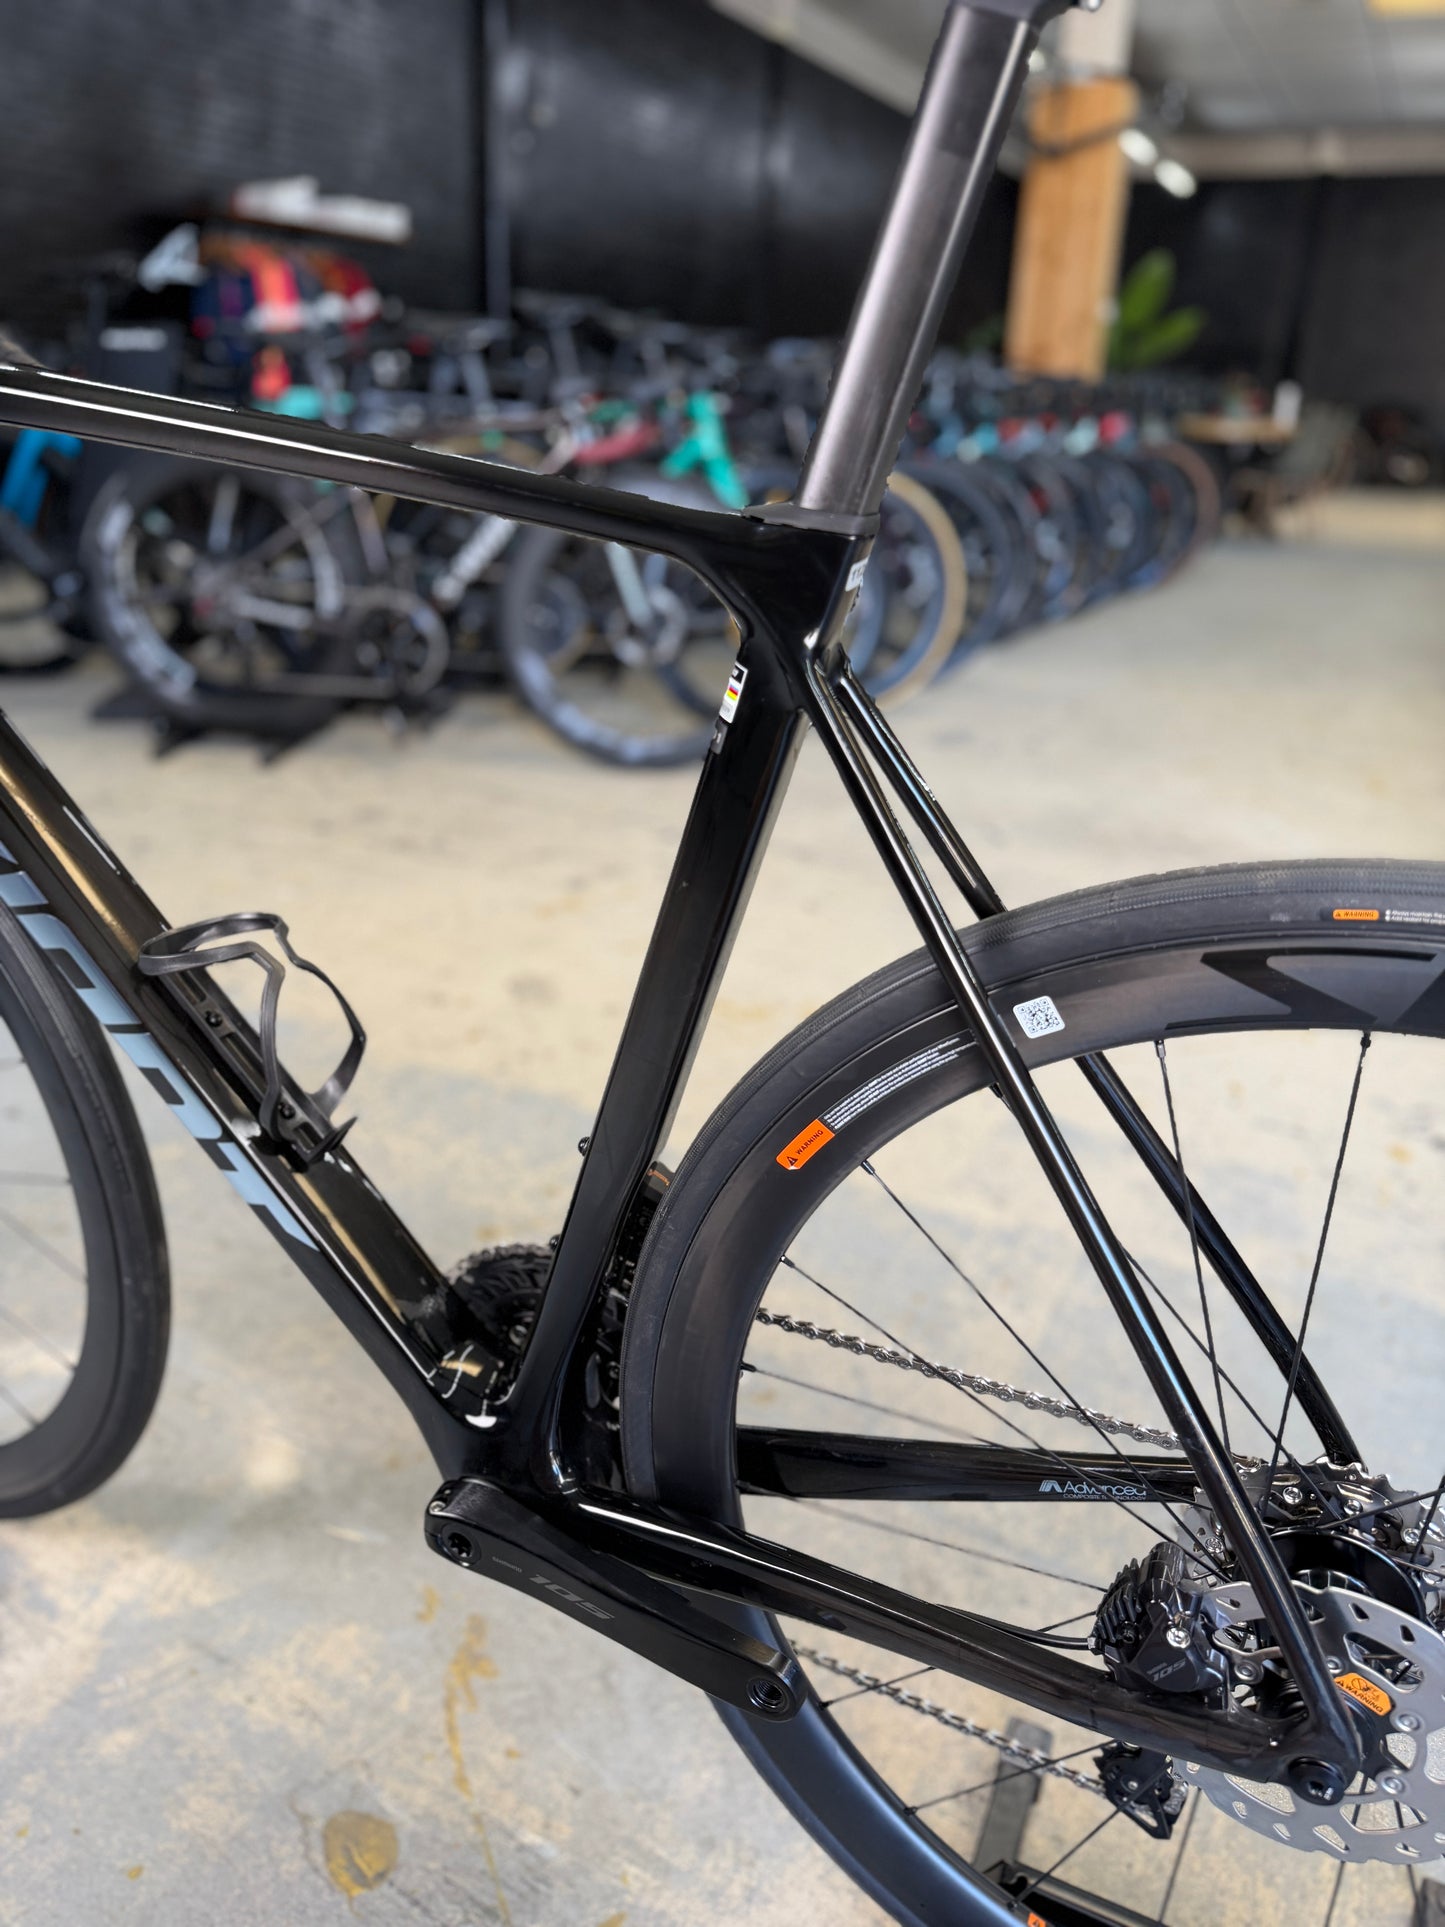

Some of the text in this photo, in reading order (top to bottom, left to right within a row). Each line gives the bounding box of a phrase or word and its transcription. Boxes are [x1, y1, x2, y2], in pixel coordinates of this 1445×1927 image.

[796, 1130, 824, 1154] WARNING
[529, 1574, 616, 1620] 105
[1346, 1684, 1384, 1712] WARNING
